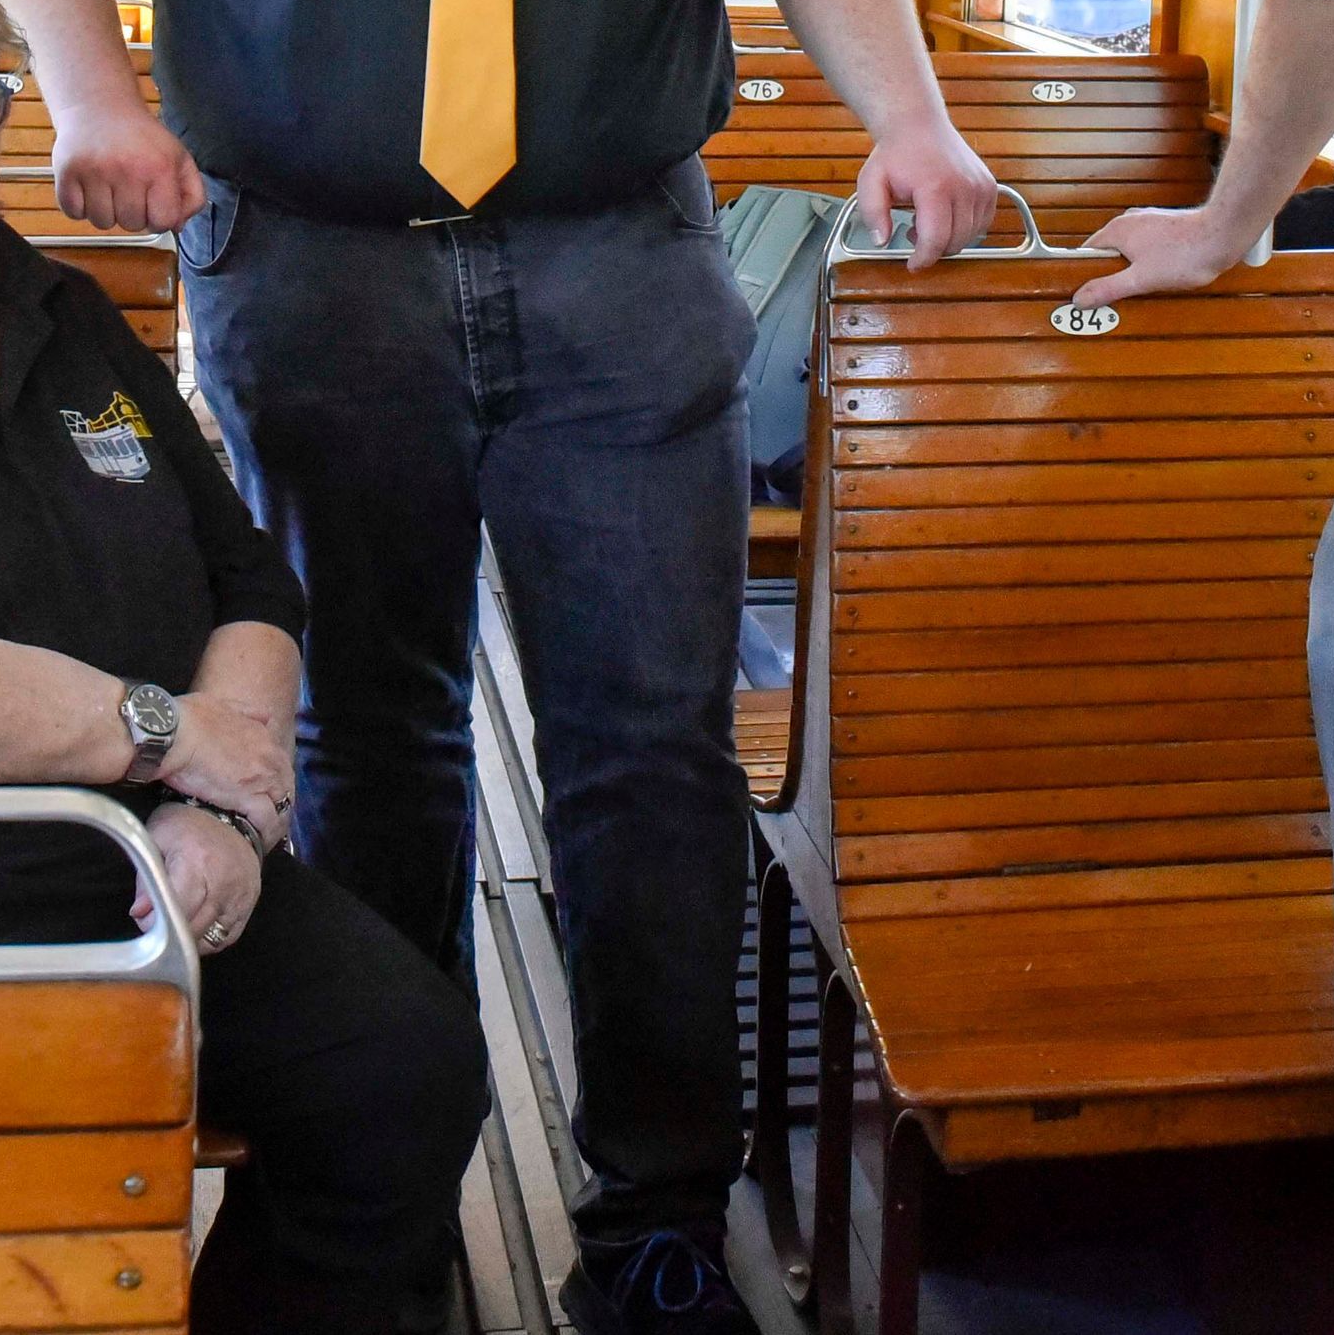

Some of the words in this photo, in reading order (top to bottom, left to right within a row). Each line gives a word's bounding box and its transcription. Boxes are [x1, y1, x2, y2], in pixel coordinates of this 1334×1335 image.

[750, 82, 772, 99] 76
[1043, 83, 1065, 100] 75
[1070, 307, 1103, 332] 84
